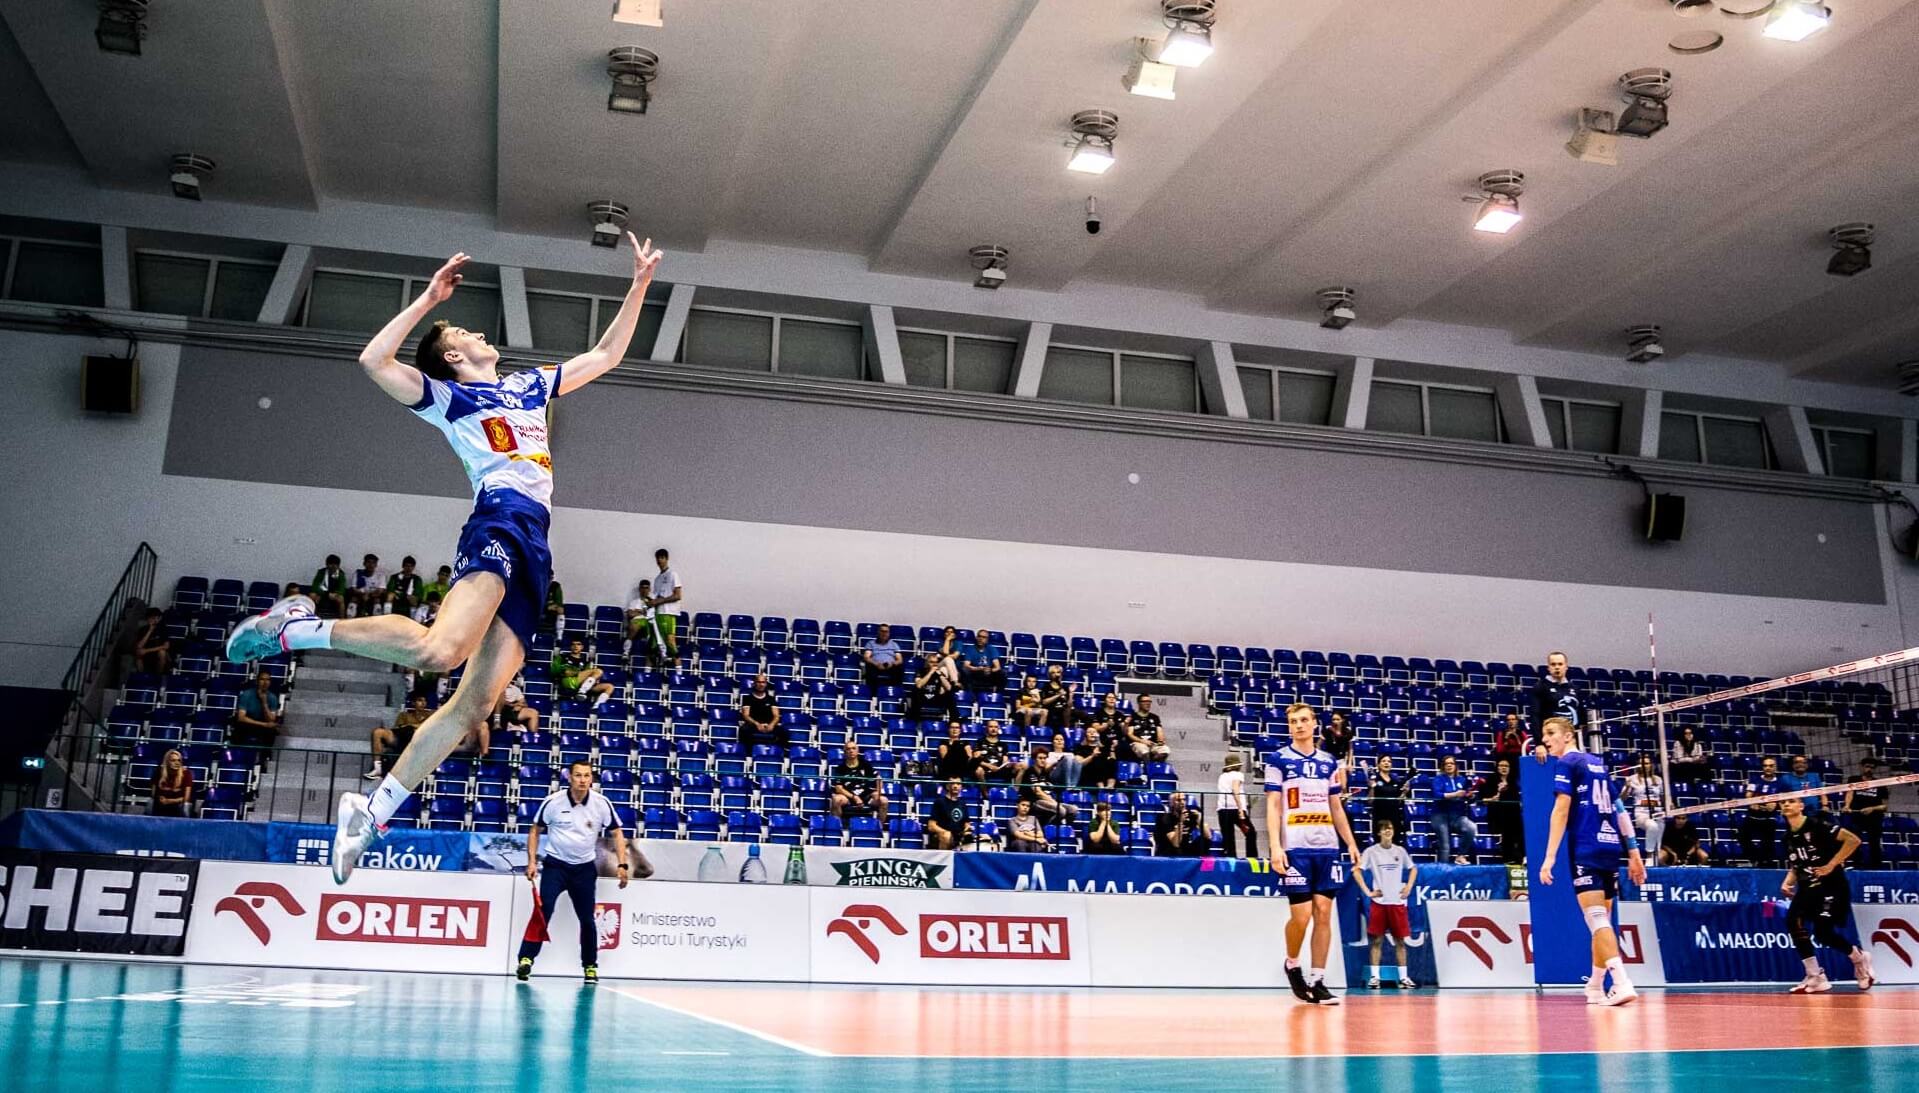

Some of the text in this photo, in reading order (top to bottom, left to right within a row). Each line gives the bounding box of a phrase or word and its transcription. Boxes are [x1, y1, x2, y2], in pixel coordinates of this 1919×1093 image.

[1303, 761, 1319, 778] 42
[1295, 814, 1329, 824] DHL
[358, 845, 442, 871] raków
[850, 860, 927, 879] KINGA
[850, 875, 927, 889] PIENIŃSKA
[0, 865, 190, 937] HEE
[1416, 883, 1491, 905] Kraków
[1670, 884, 1739, 902] Kraków
[326, 900, 480, 940] ORLEN
[632, 912, 717, 928] Ministerstwo
[632, 931, 676, 948] Sportu
[686, 933, 748, 950] Turystyki
[927, 920, 1061, 954] ORLEN
[1718, 932, 1831, 949] MAŁOPOL
